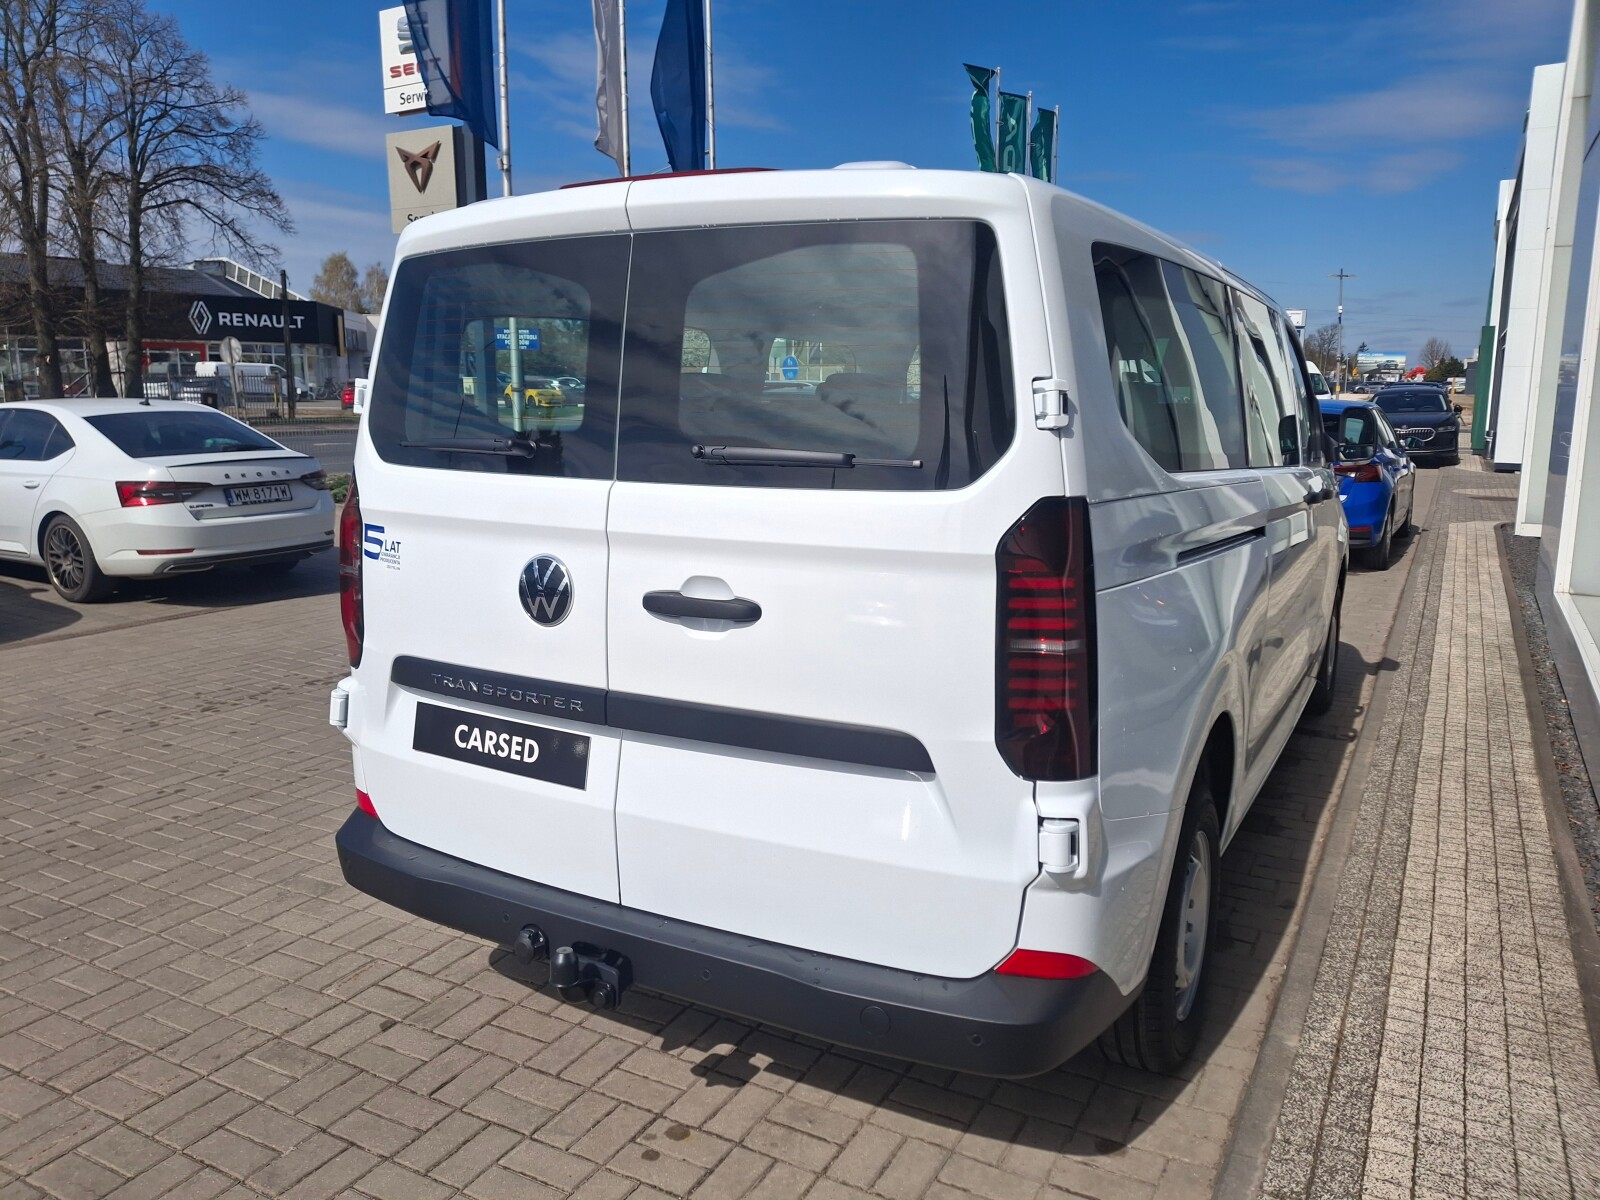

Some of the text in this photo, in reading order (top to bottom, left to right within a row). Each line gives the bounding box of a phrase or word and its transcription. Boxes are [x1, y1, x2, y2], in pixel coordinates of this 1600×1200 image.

[233, 489, 251, 502] WM
[253, 486, 288, 500] 8171W
[364, 523, 401, 560] 5 LAT
[431, 673, 584, 712] TRANSPORTER
[454, 724, 540, 764] CARSED
